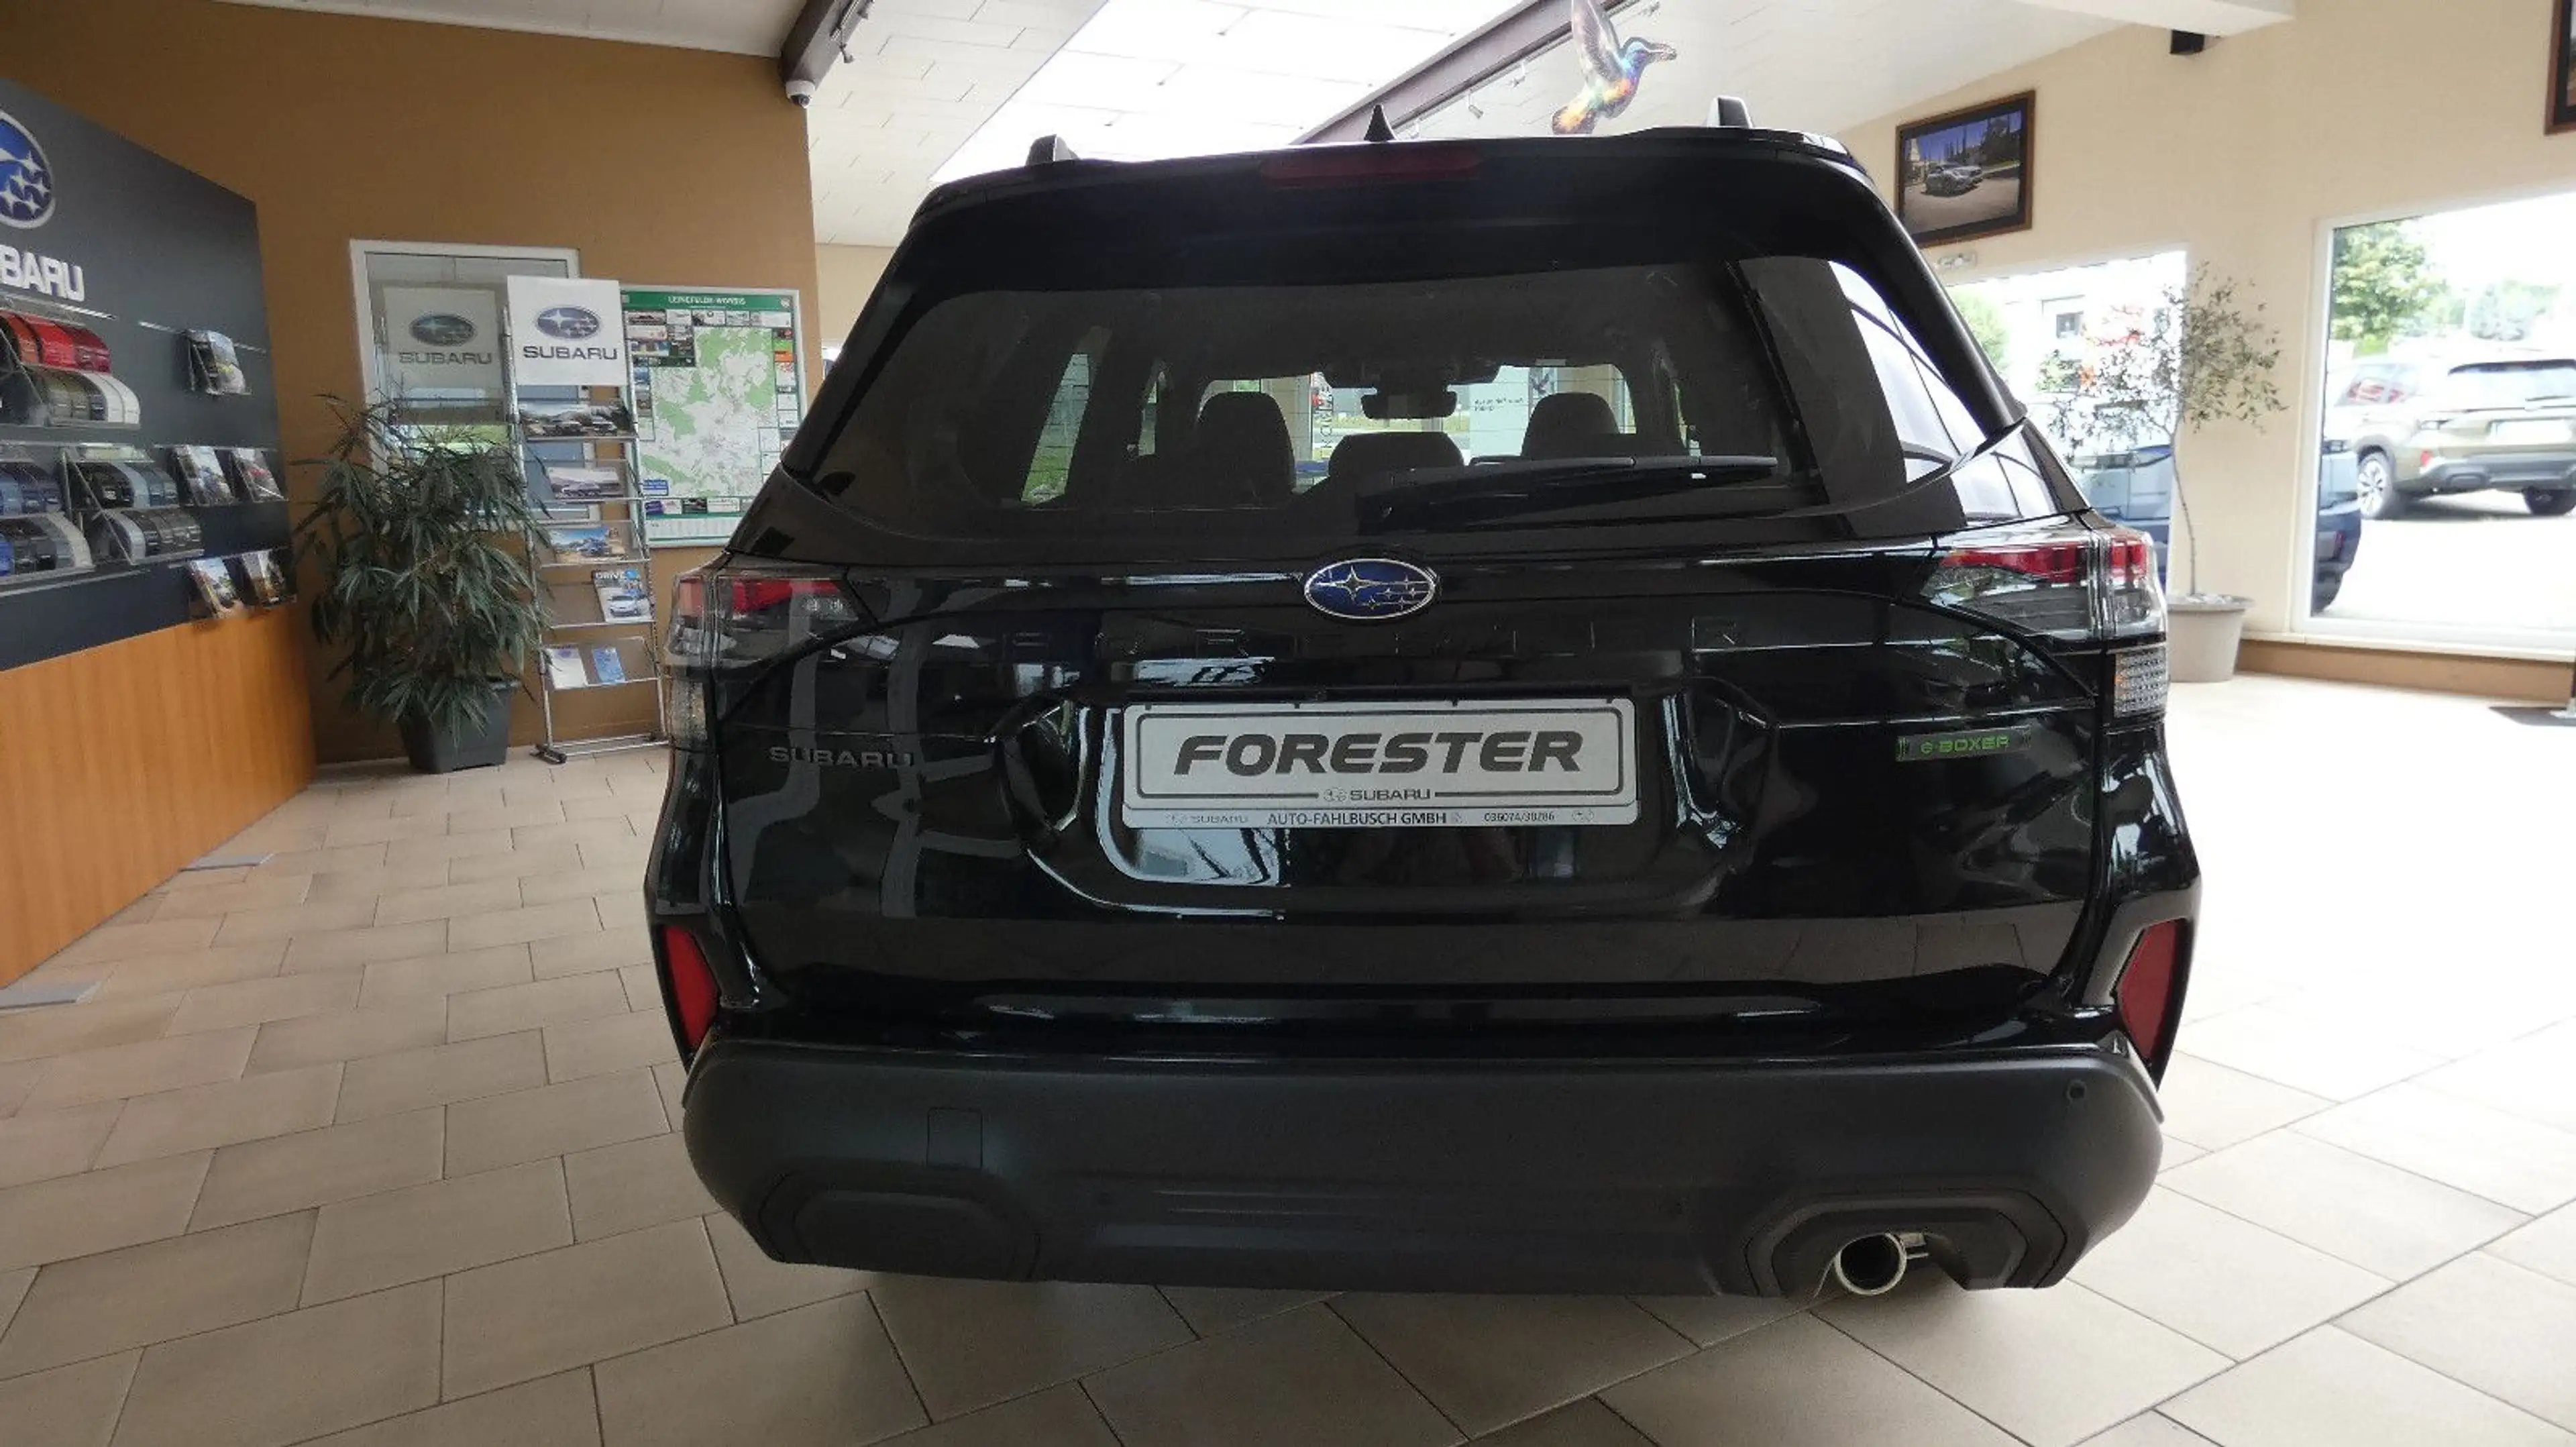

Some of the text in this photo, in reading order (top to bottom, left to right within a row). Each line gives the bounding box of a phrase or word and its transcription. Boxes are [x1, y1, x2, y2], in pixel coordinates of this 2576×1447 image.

[0, 244, 85, 302] BARU
[399, 352, 492, 365] SUBARU
[523, 345, 618, 360] SUBARU
[769, 746, 914, 768] SUBARU
[1173, 731, 1583, 777] FORESTER
[1350, 789, 1431, 801] SUBARU
[1192, 814, 1248, 824] SUBARU
[1267, 812, 1397, 826] AUTO-FAHLBUSCH
[1400, 812, 1446, 824] GMBH
